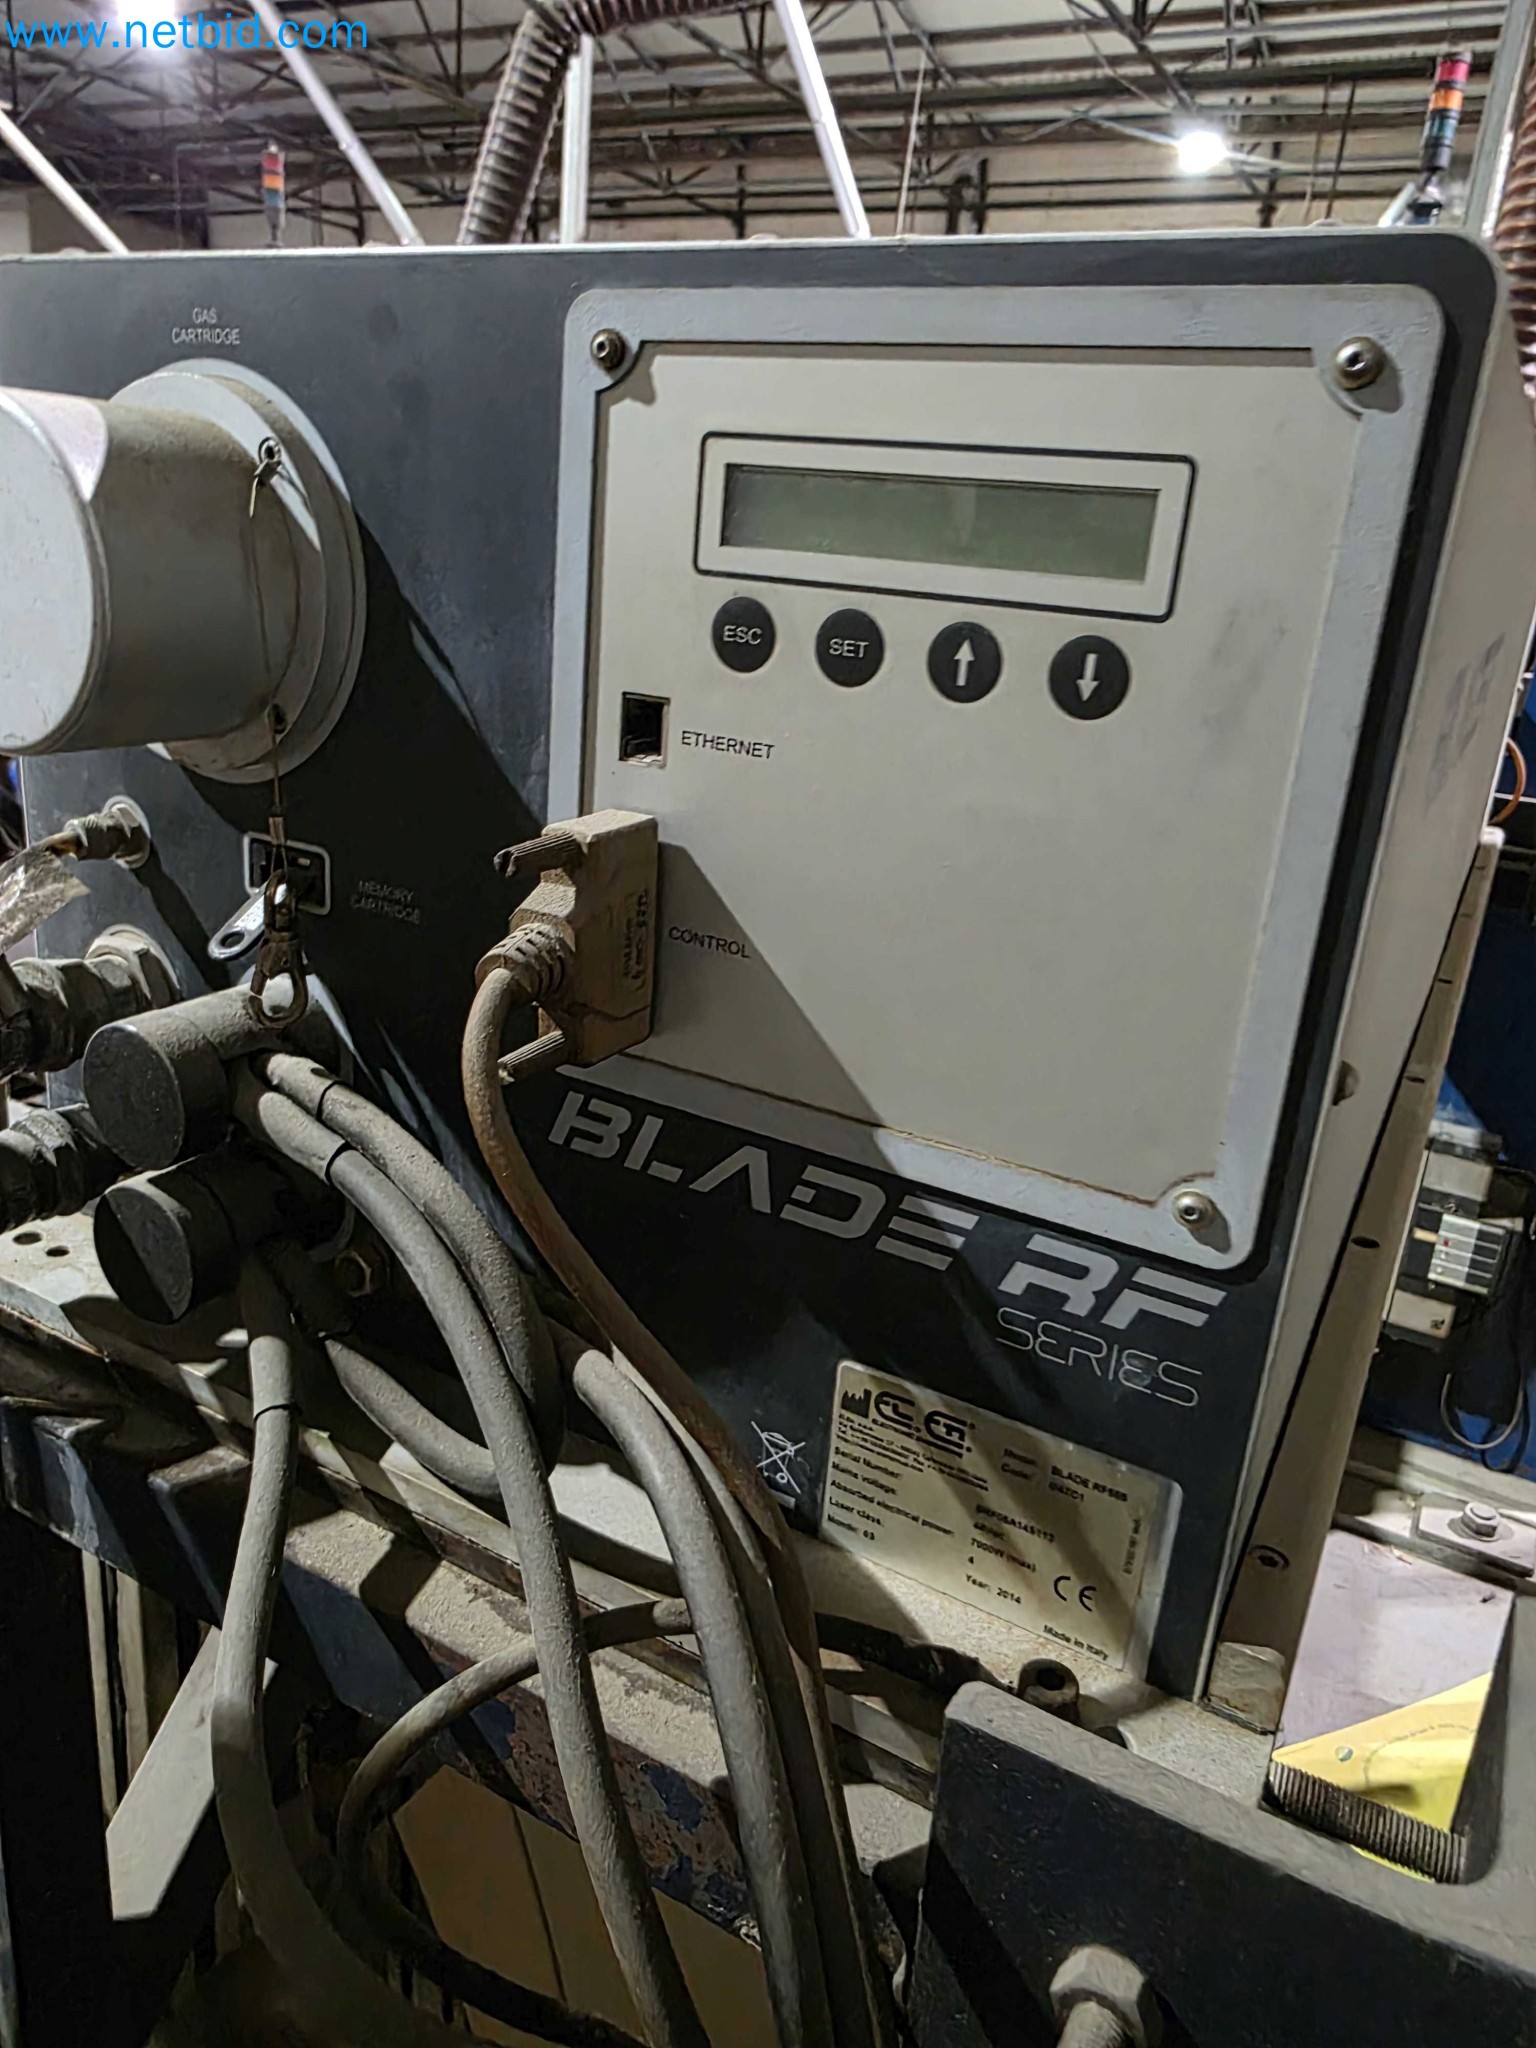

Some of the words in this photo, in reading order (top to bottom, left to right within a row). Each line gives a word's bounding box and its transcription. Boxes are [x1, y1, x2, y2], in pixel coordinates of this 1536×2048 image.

[192, 306, 218, 324] GAS
[171, 327, 241, 345] CARTRIDGE
[722, 623, 763, 647] ESC
[828, 637, 870, 660] SET
[680, 729, 775, 760] ETHERNET
[357, 880, 415, 902] MEMORY
[668, 926, 751, 959] CONTROL
[547, 1090, 982, 1272] BLADE
[997, 1233, 1228, 1331] RF
[995, 1305, 1203, 1408] SERIES
[1051, 1465, 1091, 1489] BLADE
[829, 1496, 855, 1513] Laser
[996, 1586, 1022, 1605] 2014
[1043, 1624, 1072, 1644] Made
[1086, 1643, 1109, 1662] Italy
